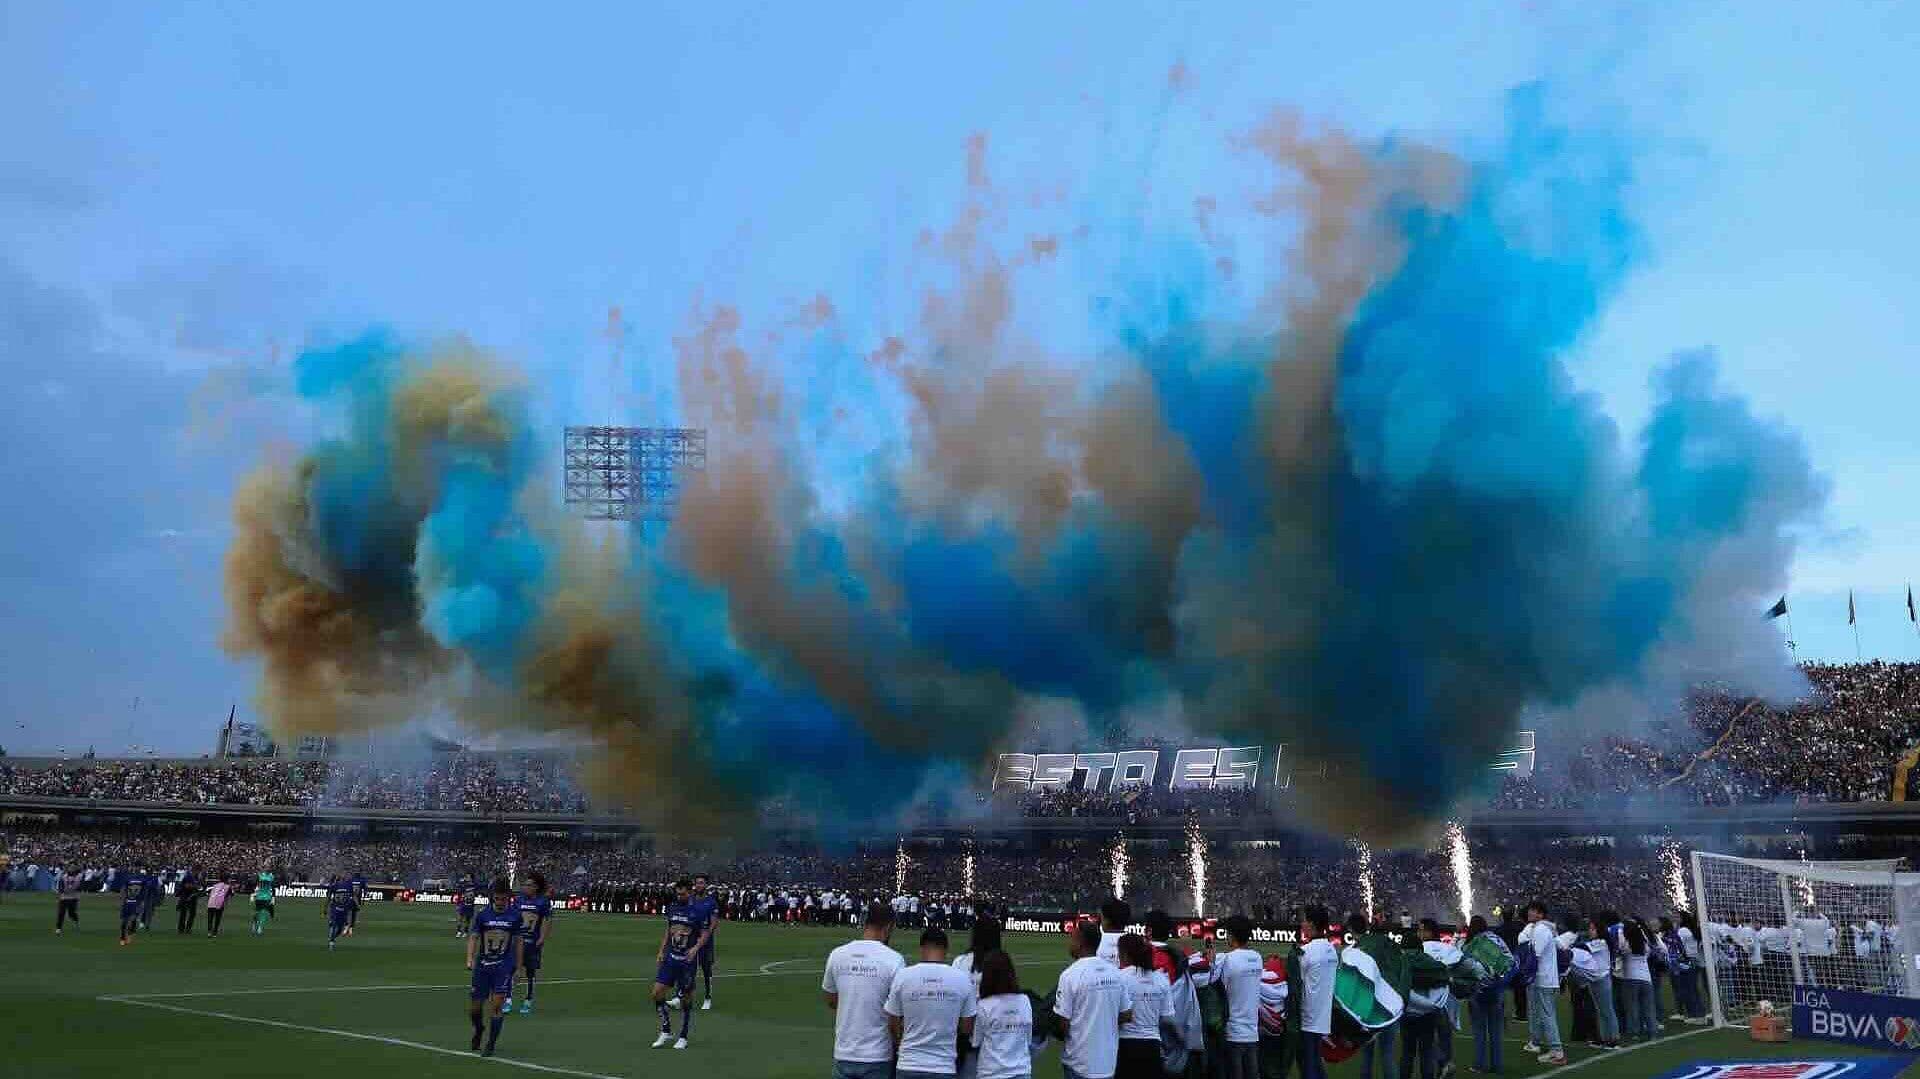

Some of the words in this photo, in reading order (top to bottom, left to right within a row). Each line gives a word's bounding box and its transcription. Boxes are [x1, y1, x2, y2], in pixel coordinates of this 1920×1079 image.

[992, 750, 1160, 791] ESTO
[1169, 746, 1261, 791] ES
[1005, 917, 1061, 932] liente.mx
[1793, 986, 1831, 1009] LIGA
[1812, 1010, 1882, 1039] BBVA
